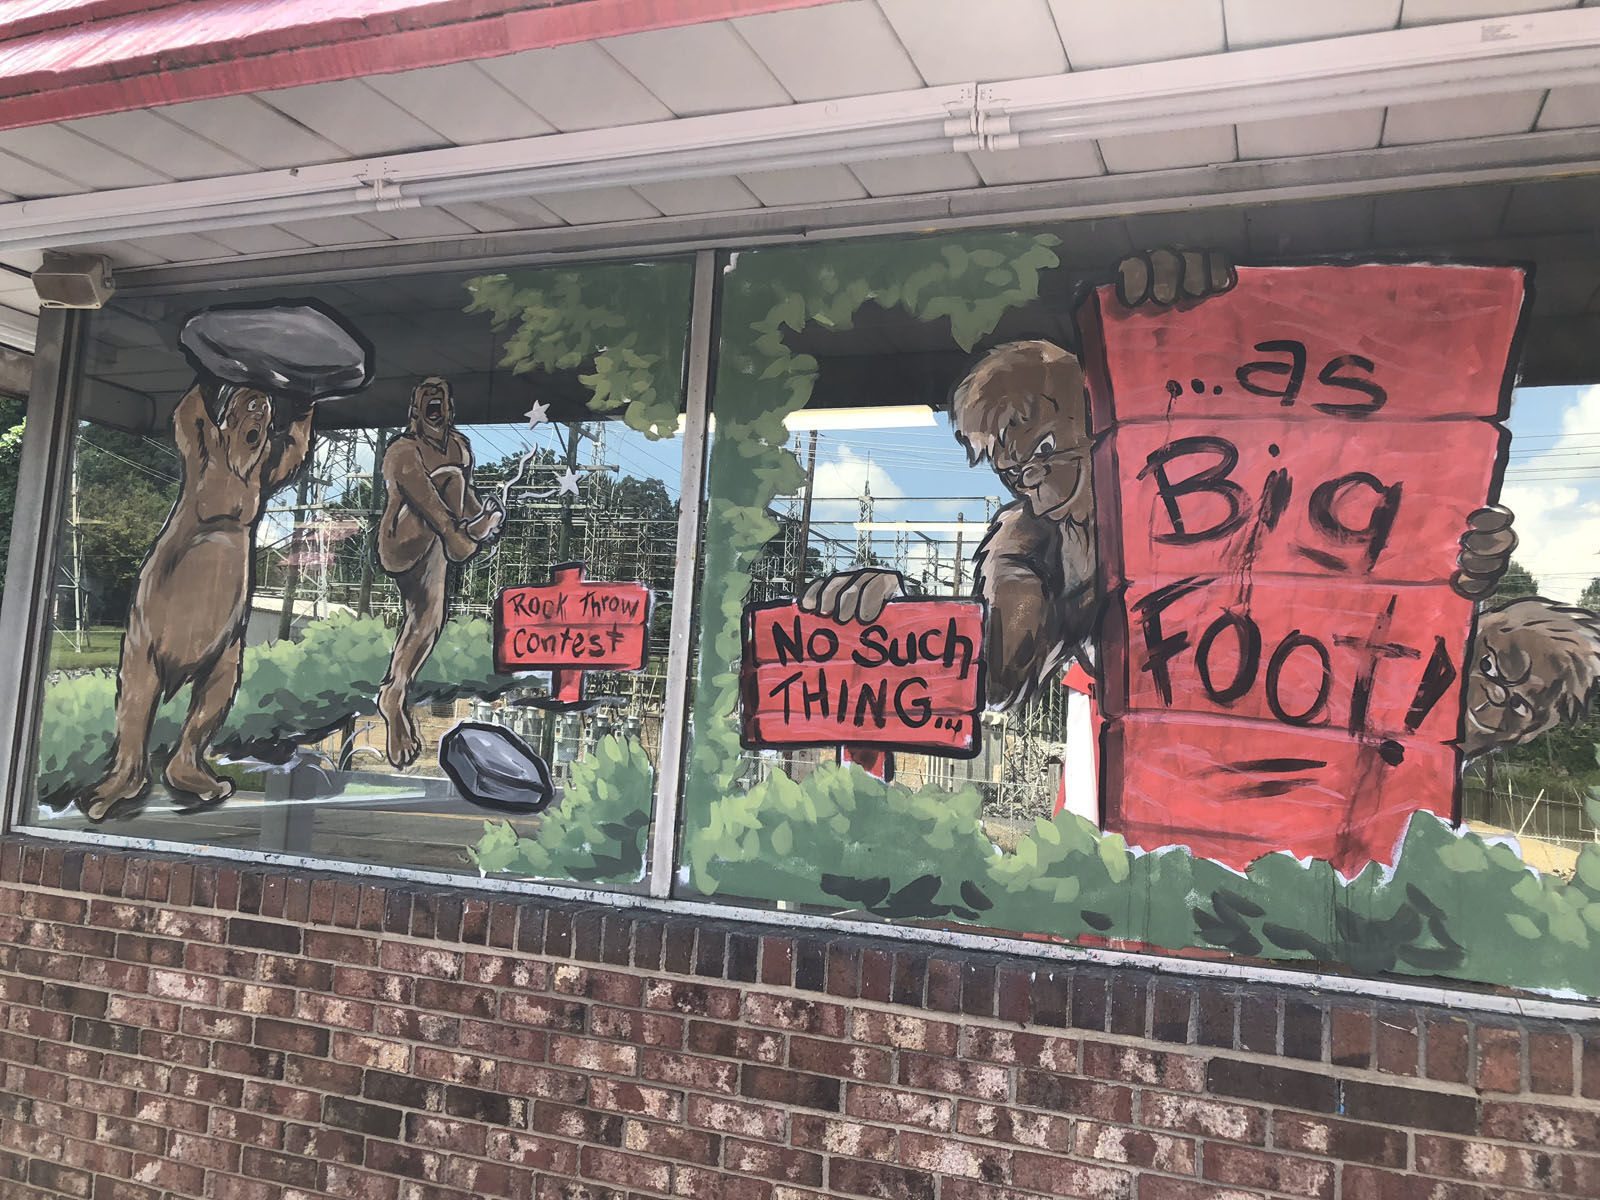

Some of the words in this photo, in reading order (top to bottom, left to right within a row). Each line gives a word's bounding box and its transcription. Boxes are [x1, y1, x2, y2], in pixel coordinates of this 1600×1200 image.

[1136, 435, 1403, 574] Big
[507, 592, 568, 621] Rock
[580, 591, 640, 618] Throw
[513, 623, 624, 658] Contest
[852, 617, 973, 680] Such
